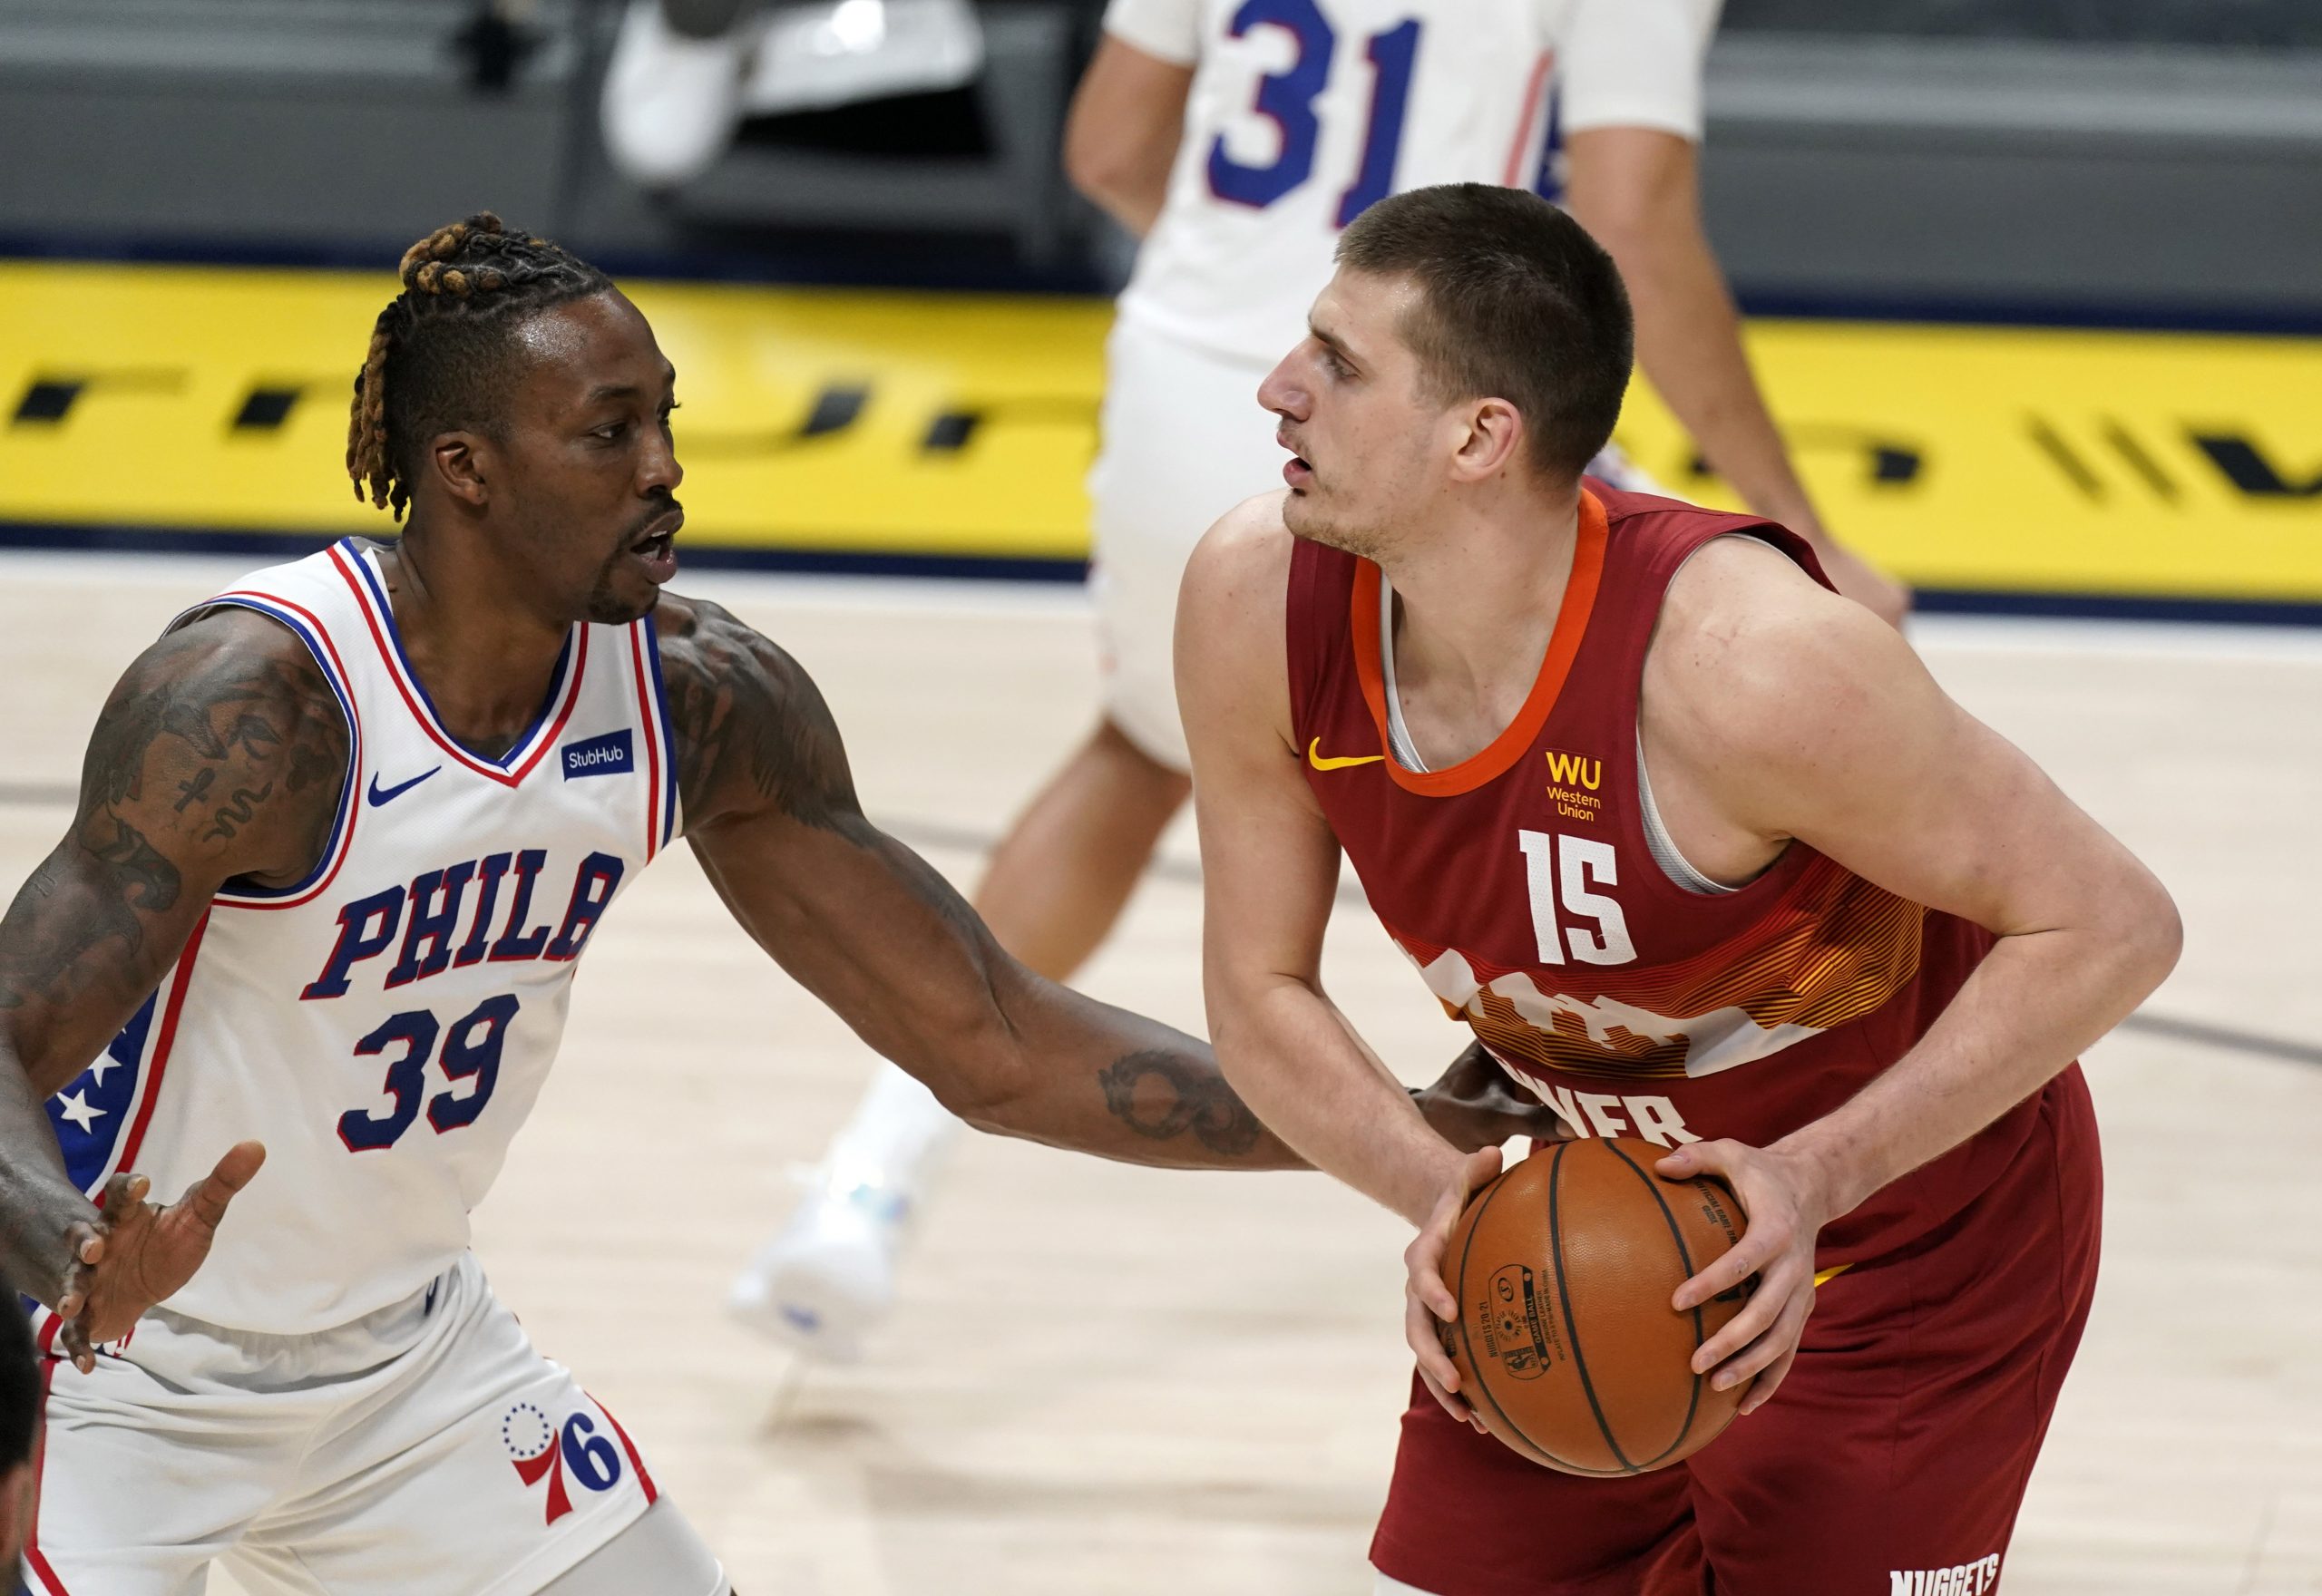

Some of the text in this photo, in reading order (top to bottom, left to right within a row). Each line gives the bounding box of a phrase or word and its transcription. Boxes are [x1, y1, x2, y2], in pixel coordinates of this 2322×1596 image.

[1206, 0, 1421, 229] 31
[569, 744, 624, 769] StubHub
[1545, 751, 1601, 790] WU
[1546, 785, 1601, 810] Western
[1557, 802, 1594, 822] Union
[1517, 829, 1638, 966] 15
[298, 849, 625, 1001] PHILA
[337, 993, 521, 1153] 39
[1526, 1296, 1537, 1319] BALL
[1482, 1325, 1498, 1358] NUGGETS
[1529, 1319, 1542, 1343] GAME
[511, 1411, 621, 1527] 76
[1889, 1552, 2000, 1596] NUGGETS
